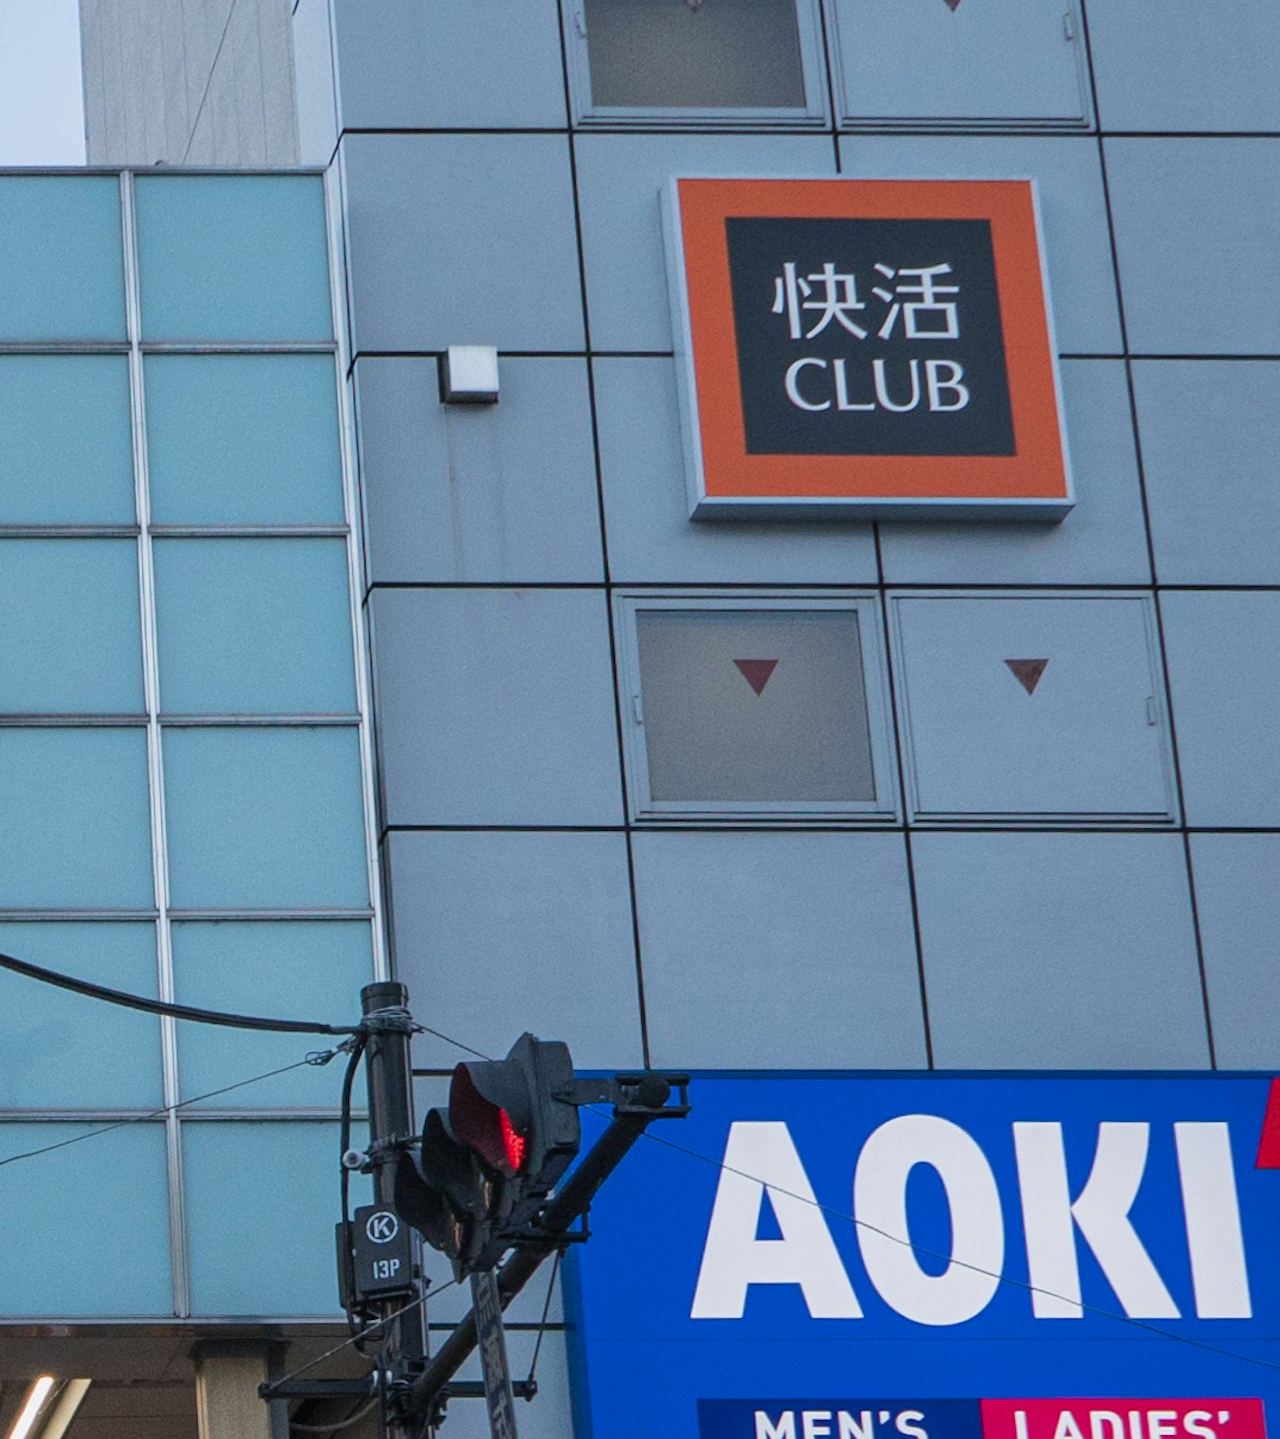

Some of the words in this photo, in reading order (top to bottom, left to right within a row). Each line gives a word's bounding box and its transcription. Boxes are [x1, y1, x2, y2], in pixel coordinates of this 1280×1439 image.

[772, 262, 960, 340] 快活
[784, 358, 970, 412] CLUB
[690, 1113, 1253, 1326] AOKI
